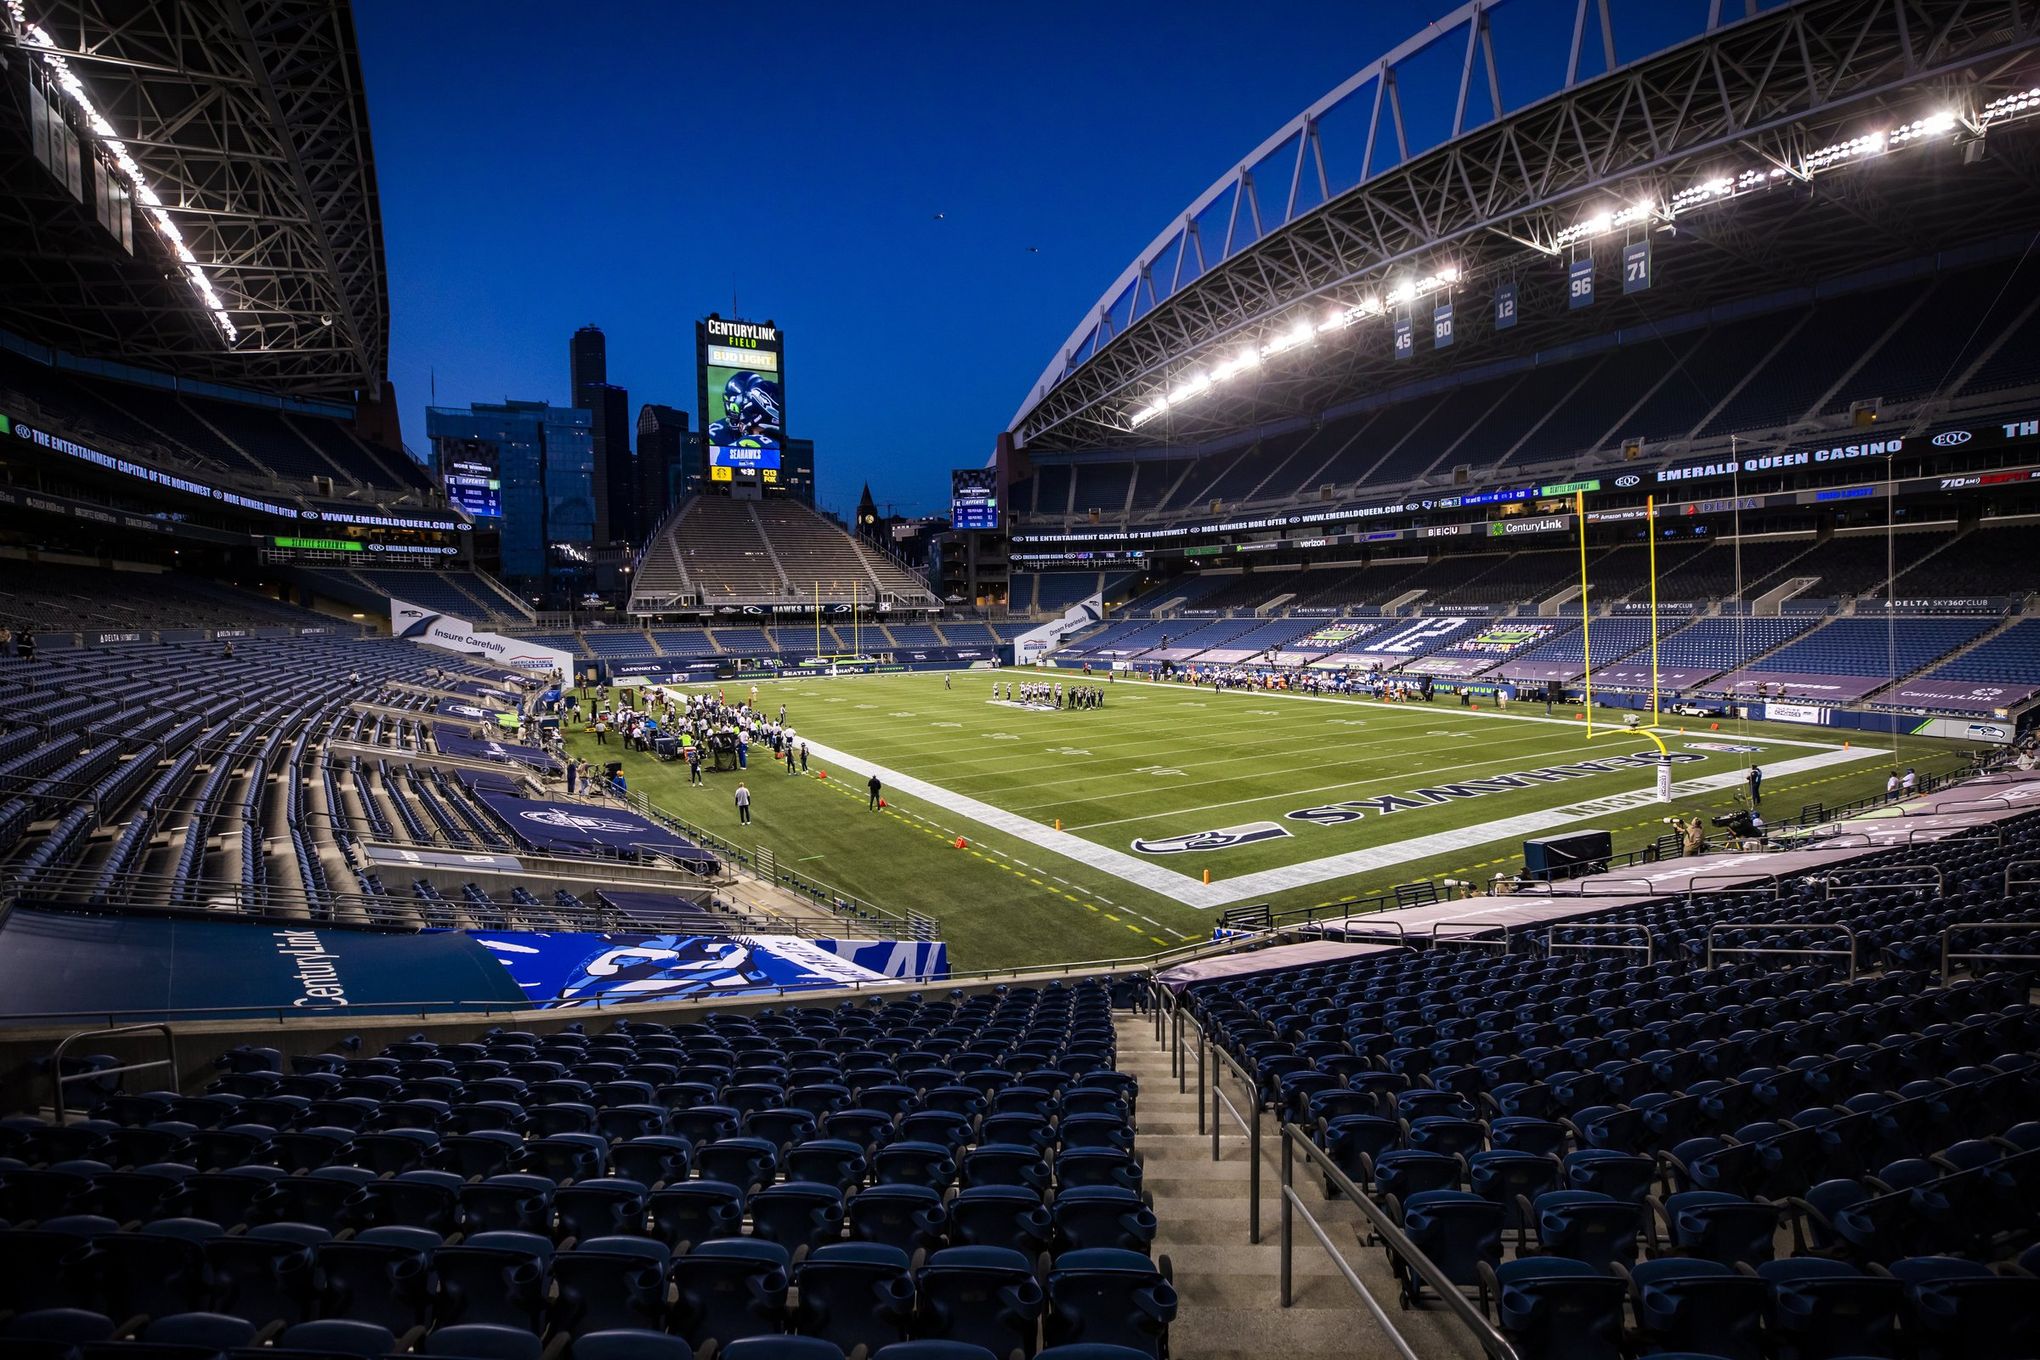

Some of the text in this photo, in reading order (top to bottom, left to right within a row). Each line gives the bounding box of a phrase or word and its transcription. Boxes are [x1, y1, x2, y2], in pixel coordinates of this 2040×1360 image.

[1627, 260, 1646, 282] 71
[1571, 277, 1592, 298] 96
[1499, 301, 1514, 319] 12
[1436, 320, 1452, 338] 80
[729, 337, 757, 349] FIELD
[1396, 333, 1411, 350] 45
[714, 351, 772, 366] BUD LIGHT
[730, 449, 762, 460] SEAHAWKS
[1657, 462, 1738, 482] EMERALD
[1745, 452, 1808, 471] QUEEN
[1815, 439, 1903, 462] CASINO
[32, 429, 50, 448] THE
[51, 436, 116, 470] ENTERTAINMENT
[117, 459, 148, 480] CAPITAL
[148, 469, 158, 482] OF
[158, 472, 171, 486] THE
[171, 476, 210, 498] NORTHWEST
[223, 492, 239, 505] MORE
[240, 496, 264, 512] WINNERS
[278, 507, 297, 519] OFTEN
[321, 512, 455, 530] WWW.EMERALDQUEEN.COM
[740, 468, 756, 476] 4:30
[1941, 479, 1965, 489] 710
[1981, 470, 2029, 486] ESPN
[1550, 482, 1590, 494] SEATTLE SEAHAWKS
[1703, 498, 1757, 512] DELTA
[1040, 533, 1097, 542] ENTERTAINMENT
[1099, 532, 1128, 540] CAPITAL
[1152, 528, 1188, 537] NORTHWEST
[1201, 525, 1219, 534] MORE
[1219, 522, 1248, 532] WINNERS
[1248, 519, 1266, 529] MORE
[1267, 517, 1287, 527] OFTEN
[1302, 504, 1404, 523] WWW.EMERALDQUEEN.COM
[1600, 511, 1621, 521] Amazon
[1622, 510, 1635, 519] Web
[1506, 519, 1562, 534] CenturyLink
[292, 540, 346, 549] SEATTLE SEAHAWKS
[386, 544, 408, 552] EMERALD
[408, 545, 424, 553] QUEEN
[424, 546, 442, 554] CASINO
[1300, 539, 1326, 548] verizon
[773, 605, 801, 613] HAWKS
[1050, 615, 1087, 637] Dream Fearlessly
[104, 634, 120, 642] DELTA
[434, 628, 506, 654] Insure Carefully
[783, 669, 816, 677] SEATTLE
[1901, 691, 1976, 701] CenturyLink
[1283, 751, 1708, 827] SEAHAWKS
[273, 929, 349, 1011] CenturyLink
